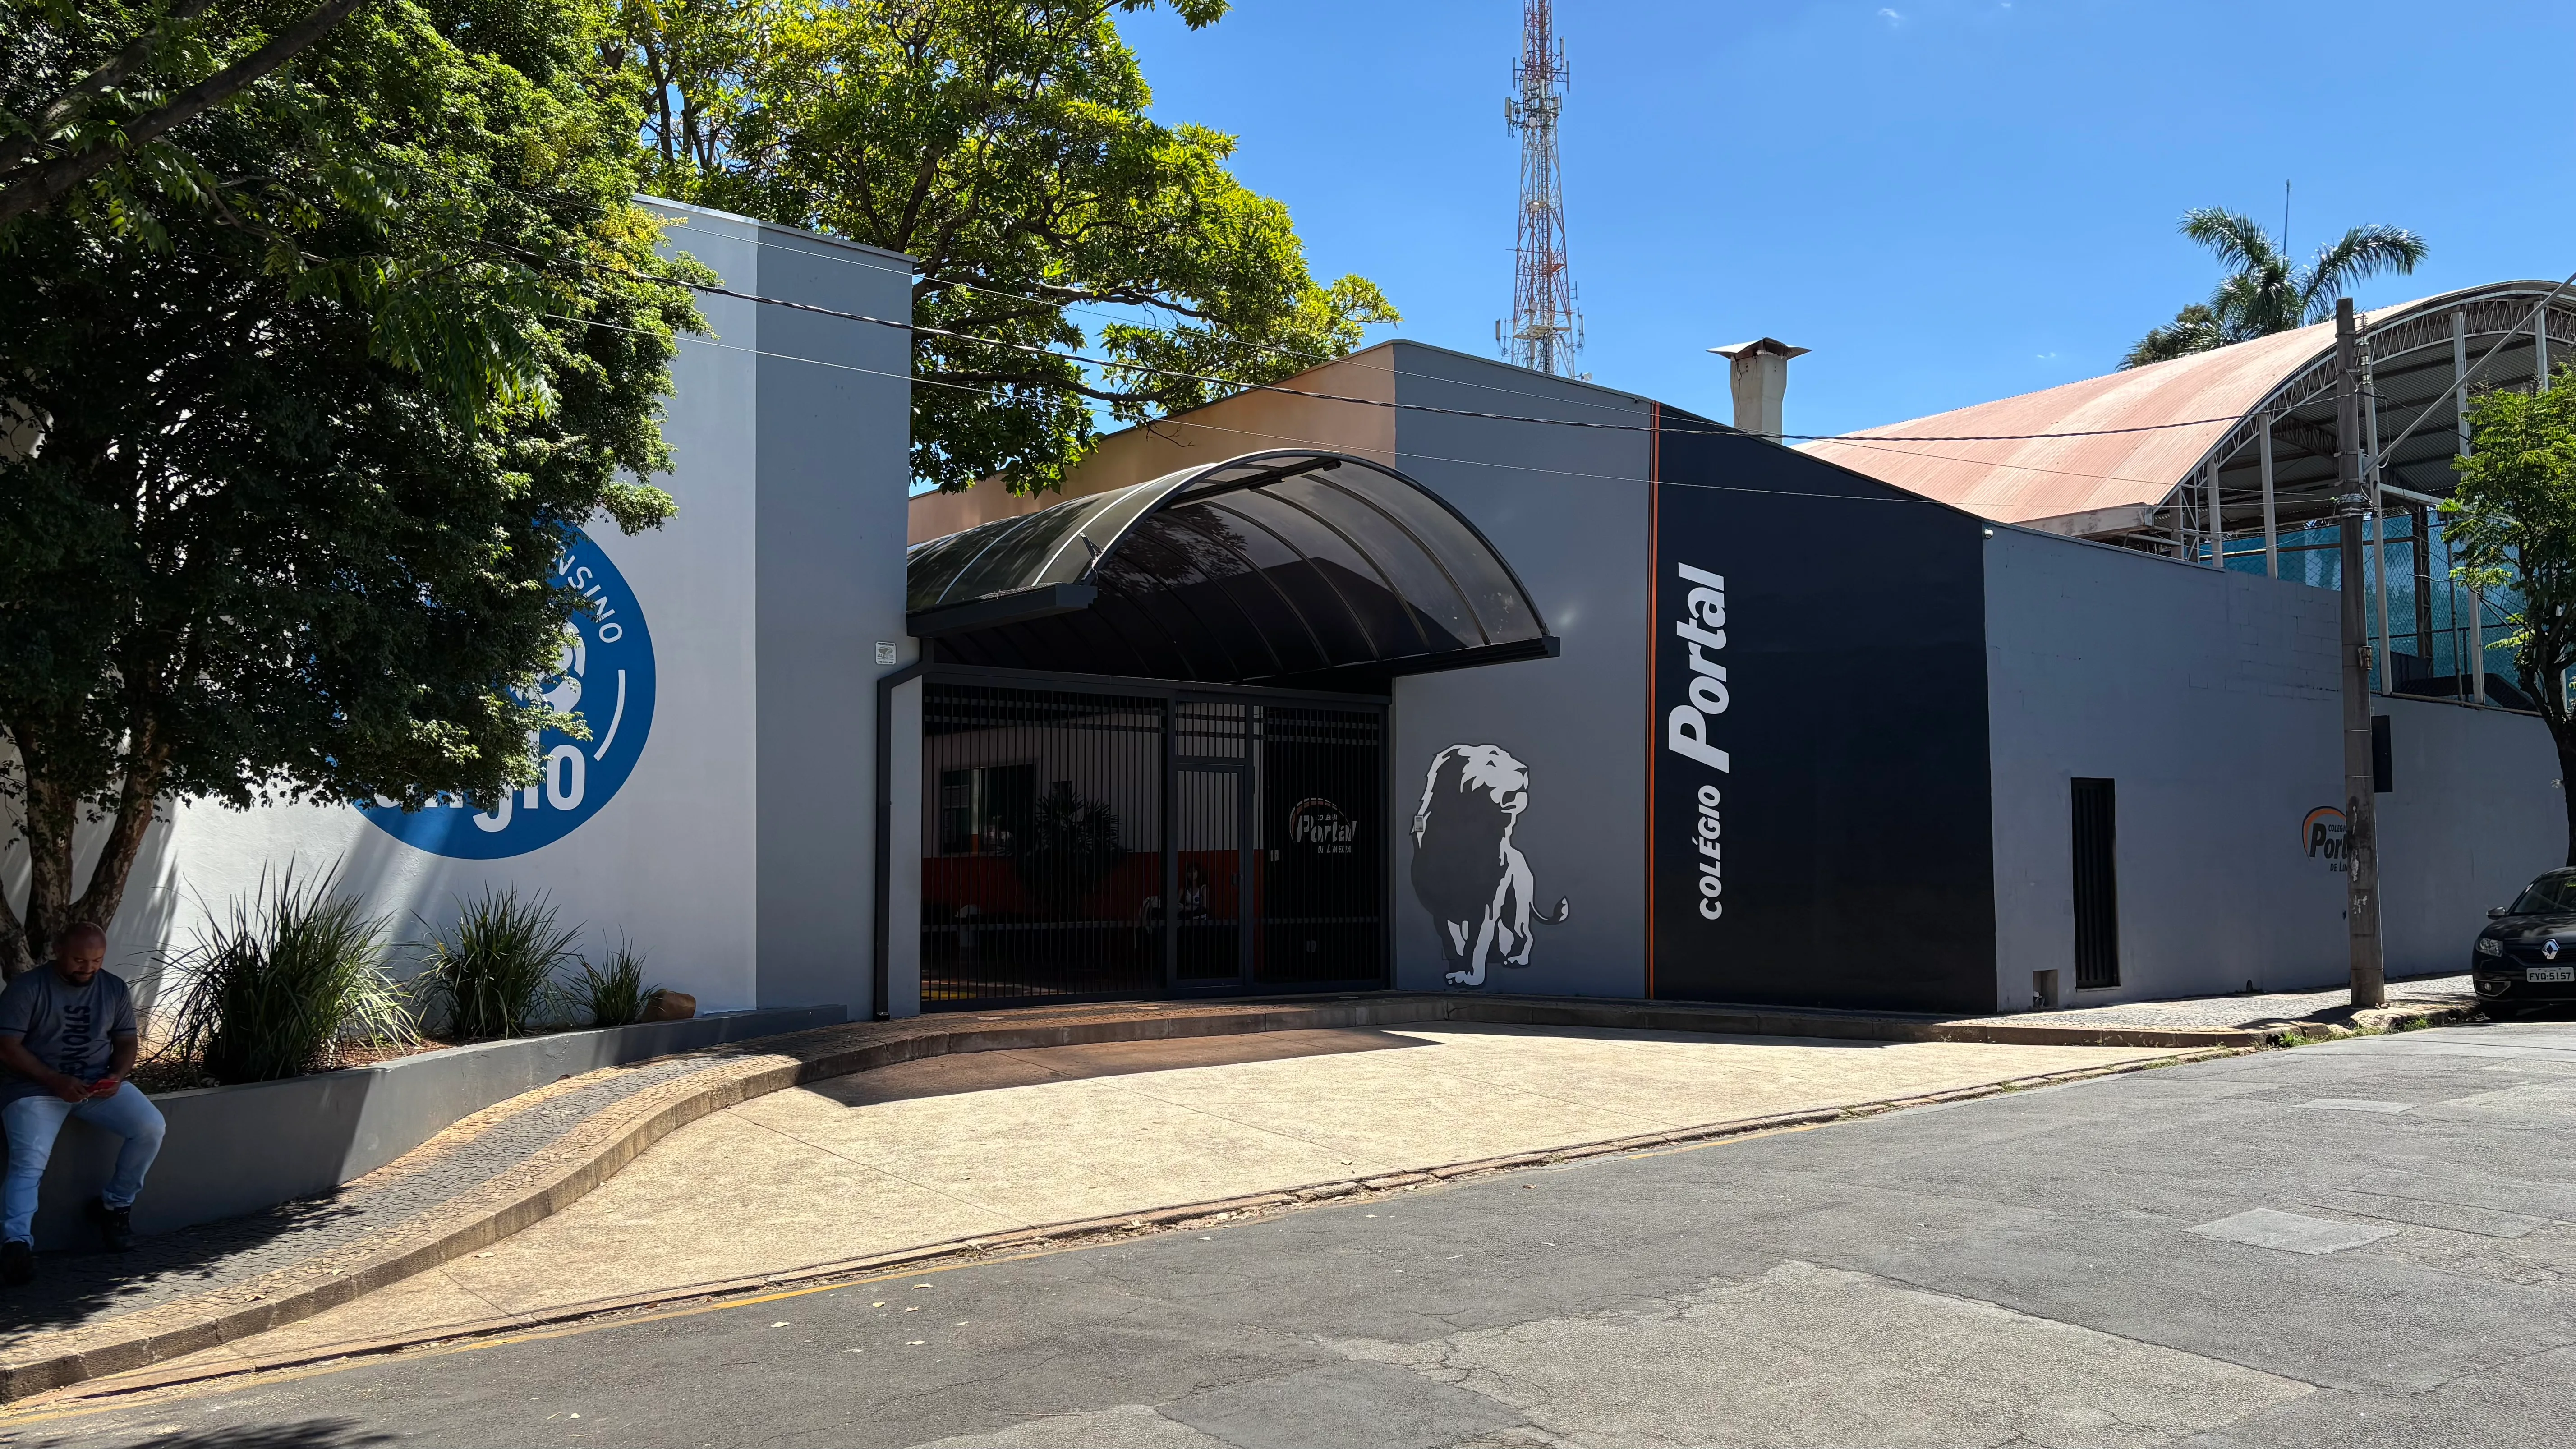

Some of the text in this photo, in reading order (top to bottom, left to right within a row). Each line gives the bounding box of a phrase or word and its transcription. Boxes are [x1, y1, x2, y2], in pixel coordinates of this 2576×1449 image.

[1668, 562, 1730, 920] COLÉGIO Portal
[1297, 815, 1357, 842] Portal
[2309, 823, 2347, 859] Port
[2330, 863, 2337, 871] DE
